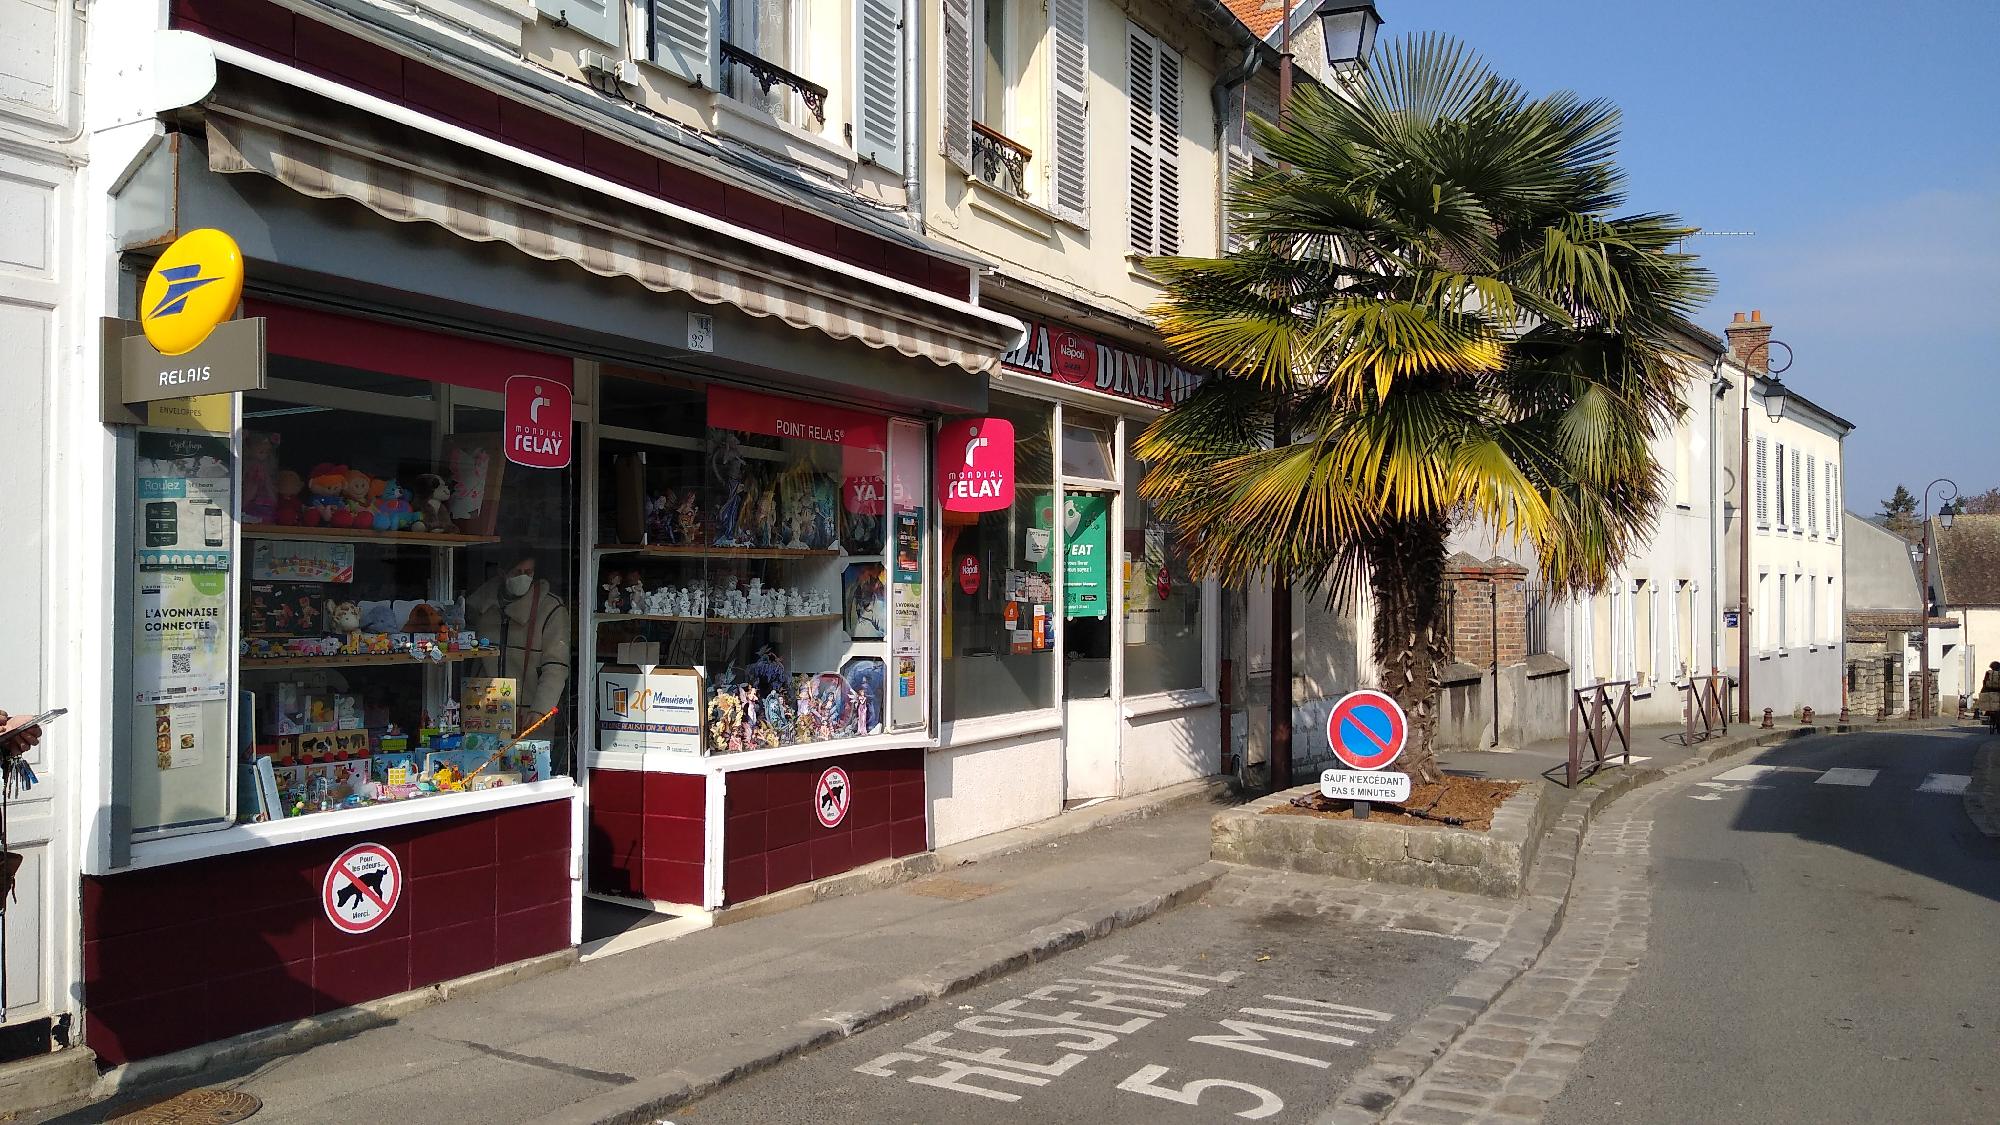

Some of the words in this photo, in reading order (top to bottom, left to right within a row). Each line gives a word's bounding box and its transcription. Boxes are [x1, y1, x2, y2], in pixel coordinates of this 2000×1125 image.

[1060, 344, 1085, 360] Napoli
[158, 366, 211, 386] RELAIS
[159, 406, 202, 417] ENVELOPPES
[515, 425, 563, 438] MONDIAL
[776, 419, 805, 439] POINT
[515, 434, 563, 456] RELAY
[948, 470, 1003, 480] MONDIAL
[144, 480, 181, 490] Roulez
[948, 479, 1003, 499] RELAY
[1071, 544, 1094, 556] EAT
[145, 608, 218, 618] L'AVONNAISE
[145, 619, 210, 632] CONNECTÉE
[630, 688, 652, 713] 2C
[652, 691, 694, 705] Menuiserie
[1324, 773, 1347, 782] SAUF
[1349, 774, 1404, 786] N'EXCÉDANT
[1331, 787, 1348, 795] PAS
[1350, 787, 1355, 795] 5
[1357, 788, 1396, 798] MINUTES
[359, 856, 374, 864] Pour
[853, 954, 1245, 1102] RESERVE
[1188, 994, 1397, 1069] MN
[1116, 1063, 1284, 1119] 5
